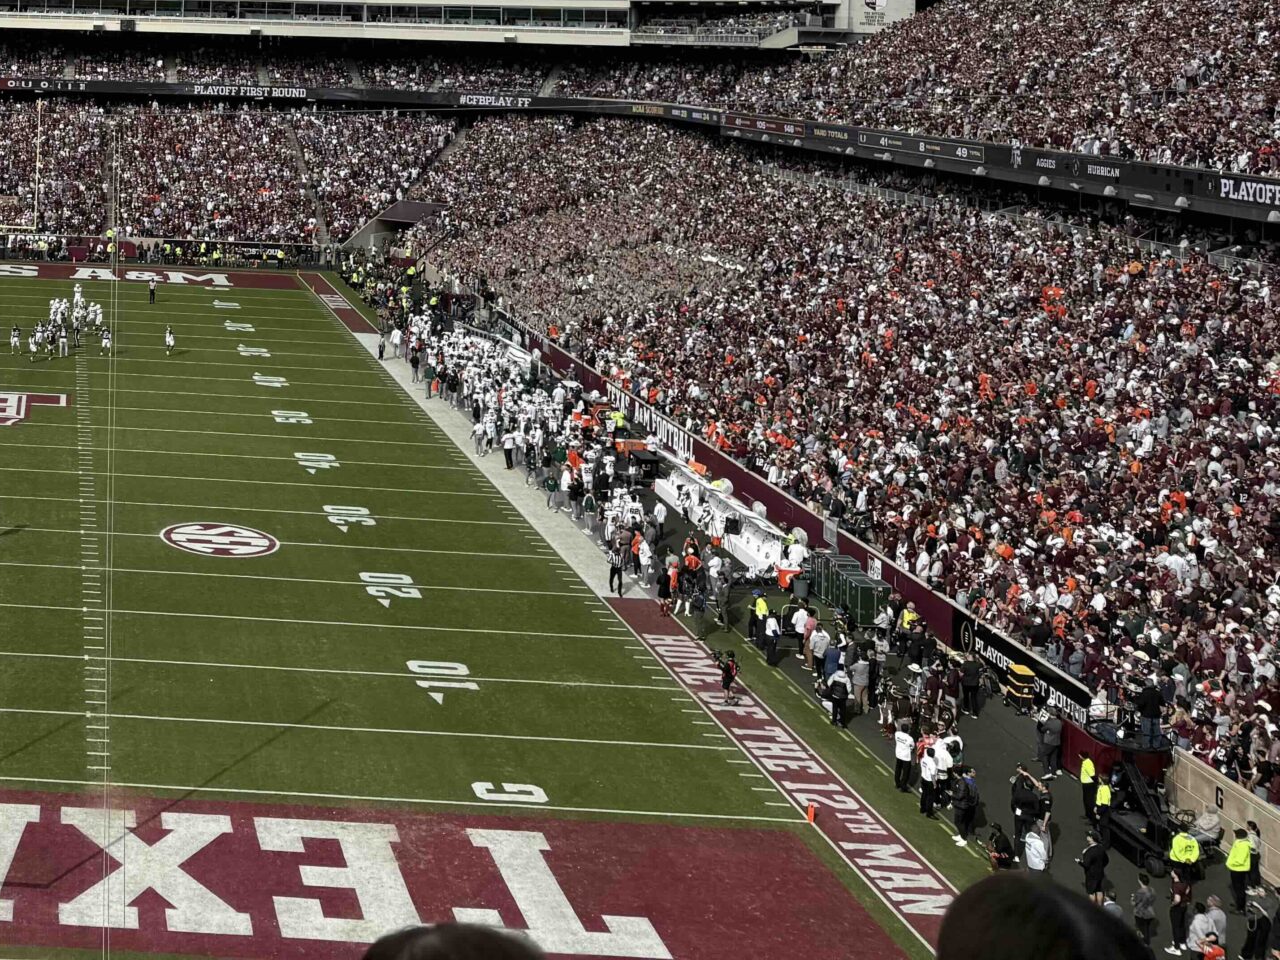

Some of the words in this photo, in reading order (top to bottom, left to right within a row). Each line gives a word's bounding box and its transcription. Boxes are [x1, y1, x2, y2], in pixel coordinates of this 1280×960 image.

[194, 85, 238, 96] PLAYOFF
[240, 86, 269, 97] FIRST
[271, 87, 307, 98] ROUND
[813, 128, 827, 138] YARD
[827, 130, 848, 140] TOTALS
[880, 137, 888, 146] 41
[955, 147, 968, 158] 49
[1036, 157, 1056, 170] AGGIES
[69, 267, 233, 286] A&M
[271, 410, 313, 424] 50
[606, 382, 630, 416] TEXAS
[651, 412, 695, 462] FOOTBALL
[294, 452, 340, 469] 40
[1239, 493, 1248, 503] 12
[322, 505, 377, 526] 30
[358, 571, 423, 599] 20
[641, 633, 724, 686] HOME
[405, 660, 481, 691] 10
[696, 691, 771, 721] OF
[1049, 686, 1087, 725] ROUND
[730, 727, 828, 776] THE
[471, 781, 550, 803] G
[1215, 786, 1224, 810] G
[780, 780, 890, 836] 12TH
[838, 840, 959, 916] MAN
